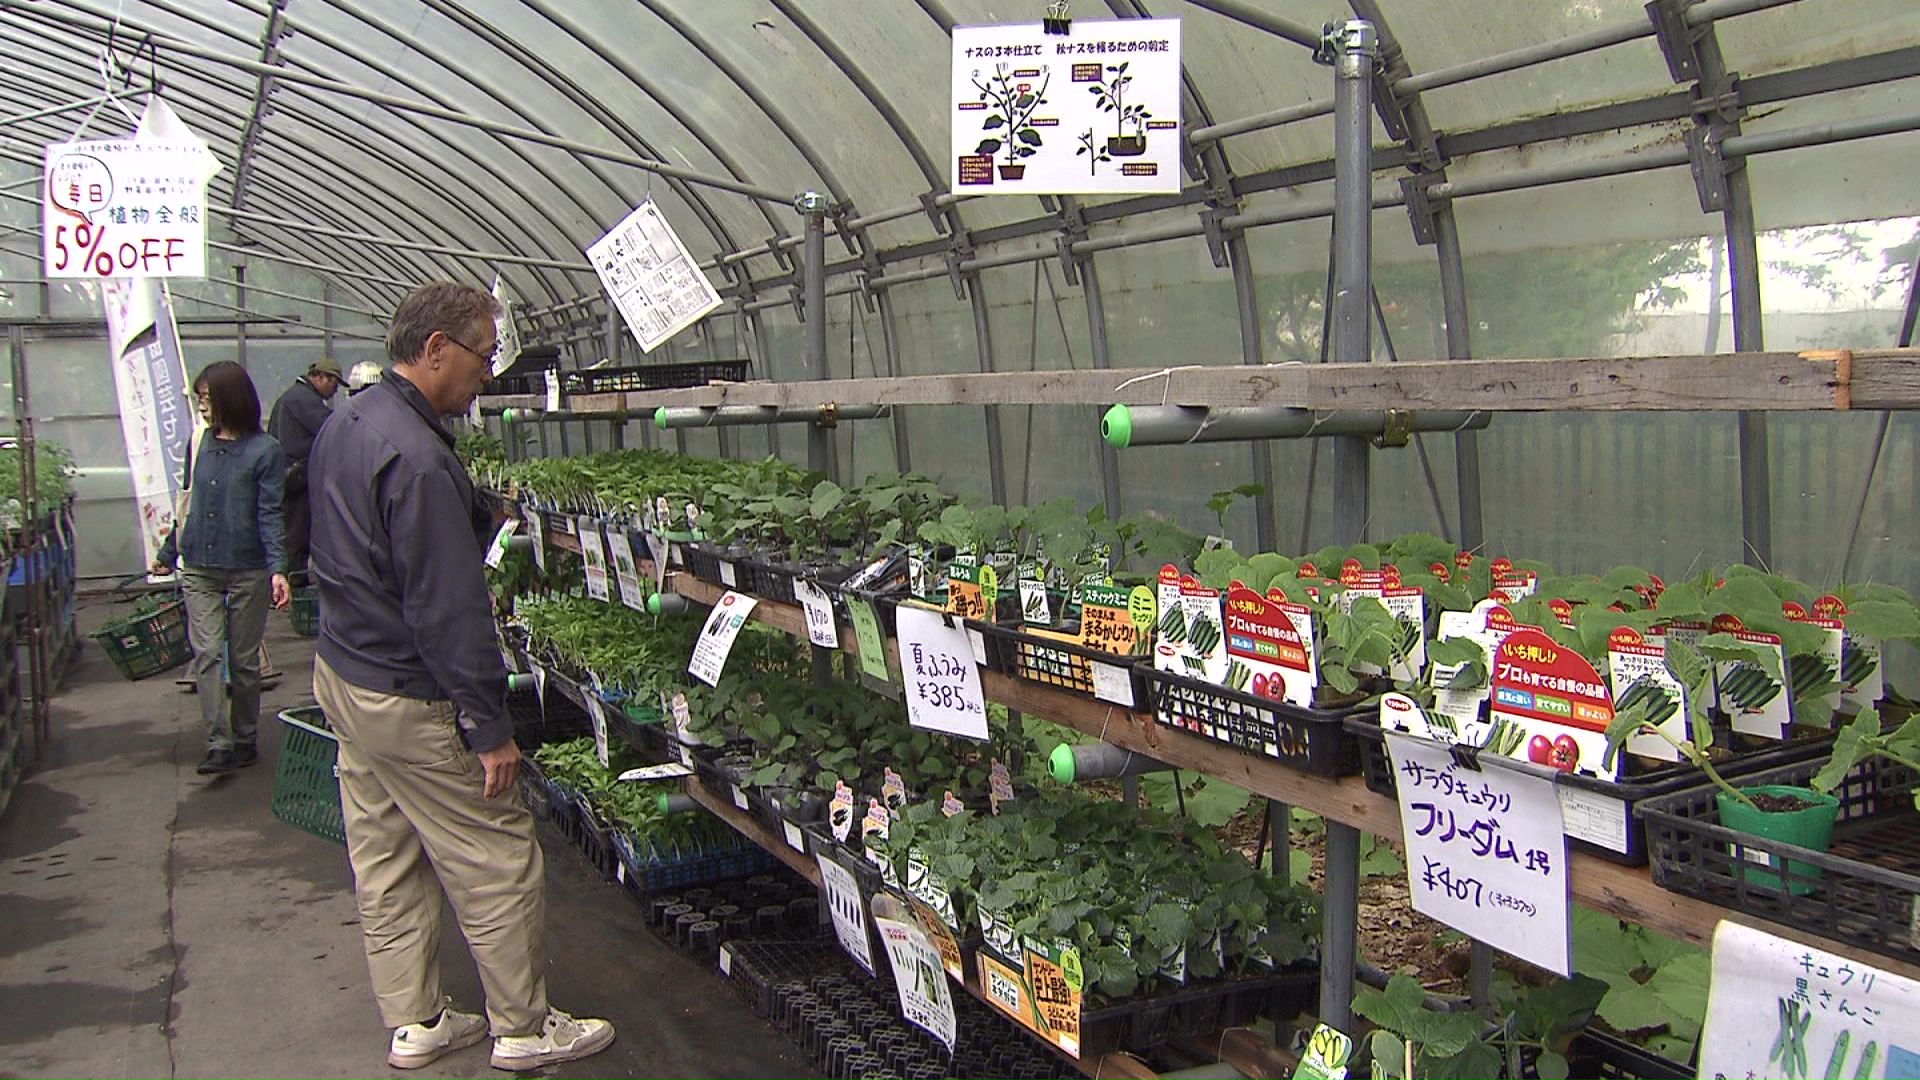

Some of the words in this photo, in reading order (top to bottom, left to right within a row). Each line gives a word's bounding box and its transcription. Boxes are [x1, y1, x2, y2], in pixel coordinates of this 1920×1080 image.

[108, 205, 200, 225] 植物全般
[1085, 607, 1116, 621] そのまんま
[1086, 588, 1128, 606] スティックミニ
[1132, 595, 1152, 611] ミニ
[1084, 620, 1134, 642] まるかじり!
[910, 643, 967, 683] 夏ふうみ
[917, 681, 965, 712] ¥385
[1498, 662, 1605, 700] プロも育てる自慢の品種
[1498, 690, 1532, 705] 病気に強い
[1535, 696, 1571, 713] 育てやすい
[1402, 760, 1512, 814] サラダキュウリ
[1412, 802, 1520, 864] フリーダム
[1525, 849, 1551, 876] 1号
[1422, 855, 1484, 909] ¥407
[1799, 952, 1876, 994] キュウリ
[1791, 976, 1881, 1026] 黒さんご
